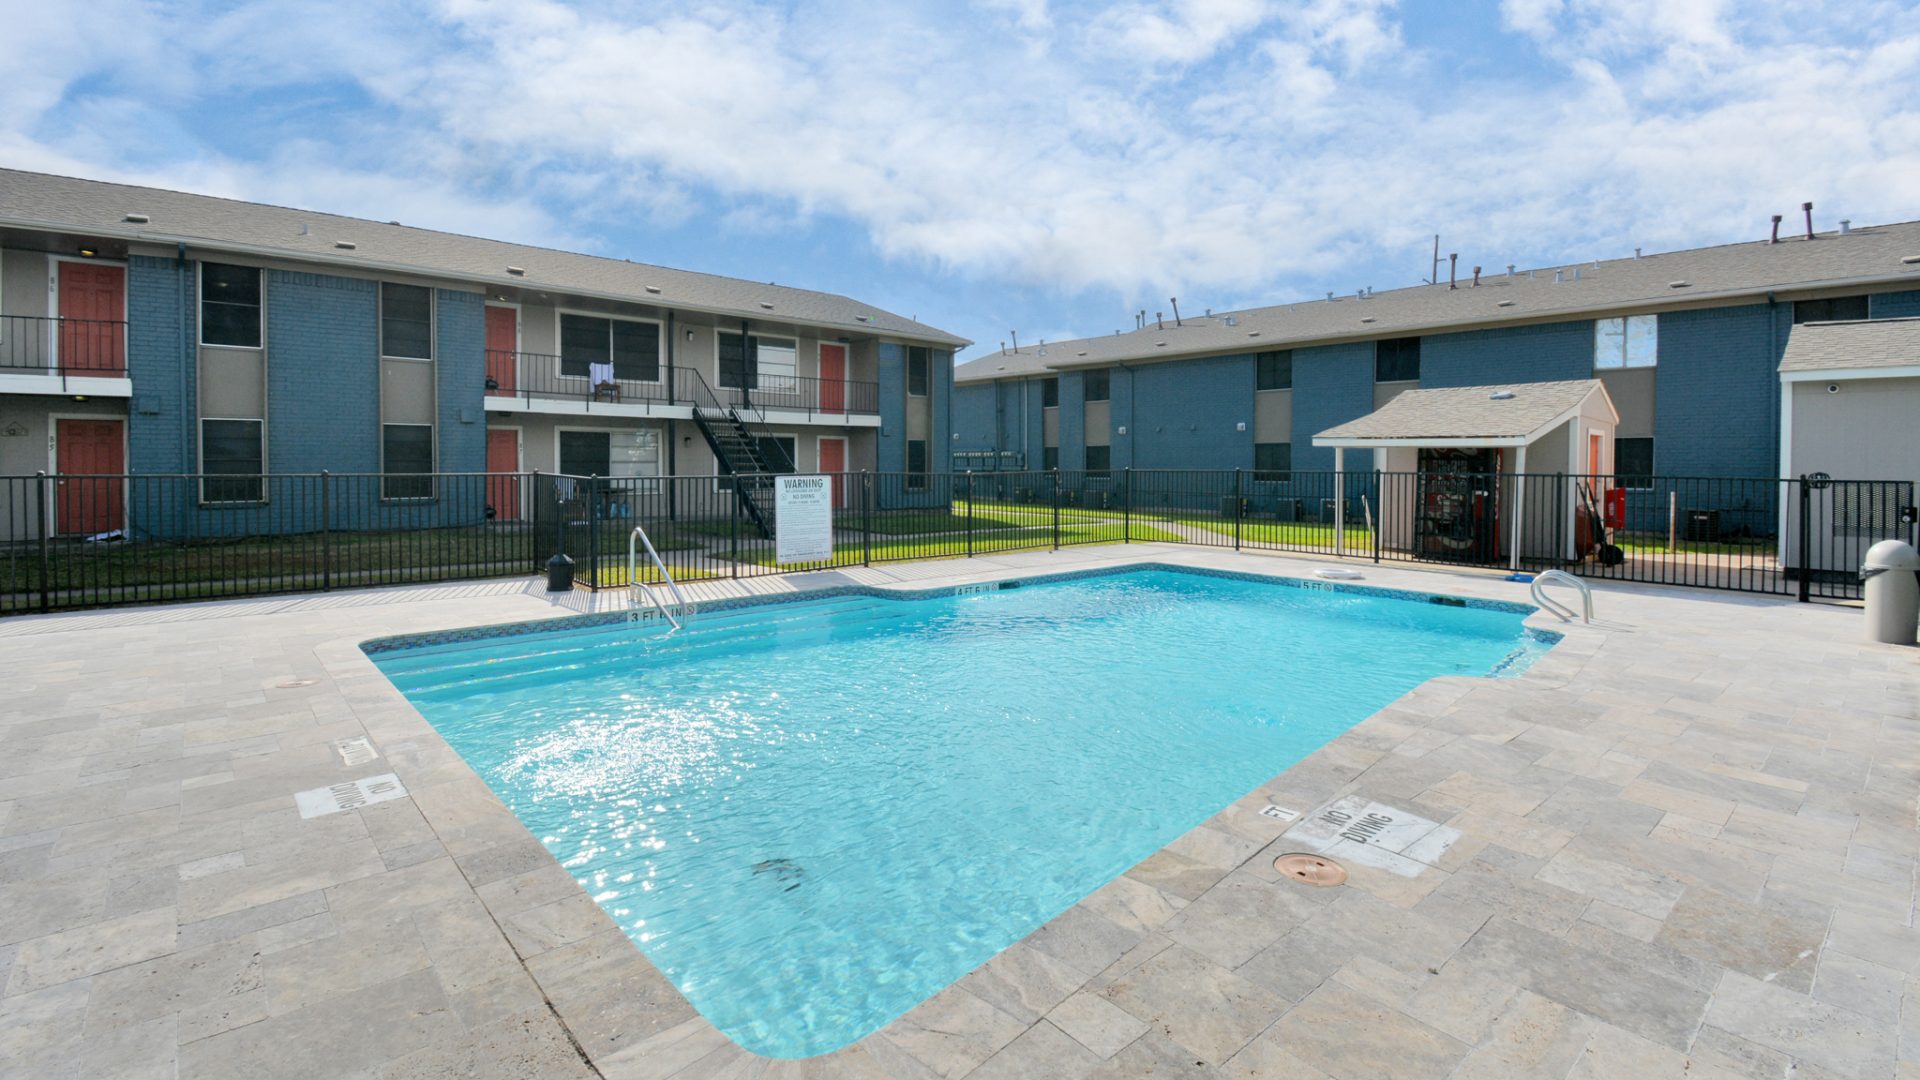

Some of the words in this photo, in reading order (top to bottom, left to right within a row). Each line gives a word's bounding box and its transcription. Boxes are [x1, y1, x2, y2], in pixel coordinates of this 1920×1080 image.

[784, 478, 824, 489] WARNING
[957, 588, 962, 596] 4
[1303, 581, 1309, 590] 5
[1311, 583, 1322, 591] FT
[631, 613, 639, 622] 3
[642, 610, 655, 621] FT
[671, 608, 682, 617] IN
[366, 780, 396, 794] NO
[329, 782, 367, 809] DIVING
[1264, 806, 1294, 820] FT
[1318, 809, 1353, 827] NO
[1339, 812, 1393, 845] DIVING
